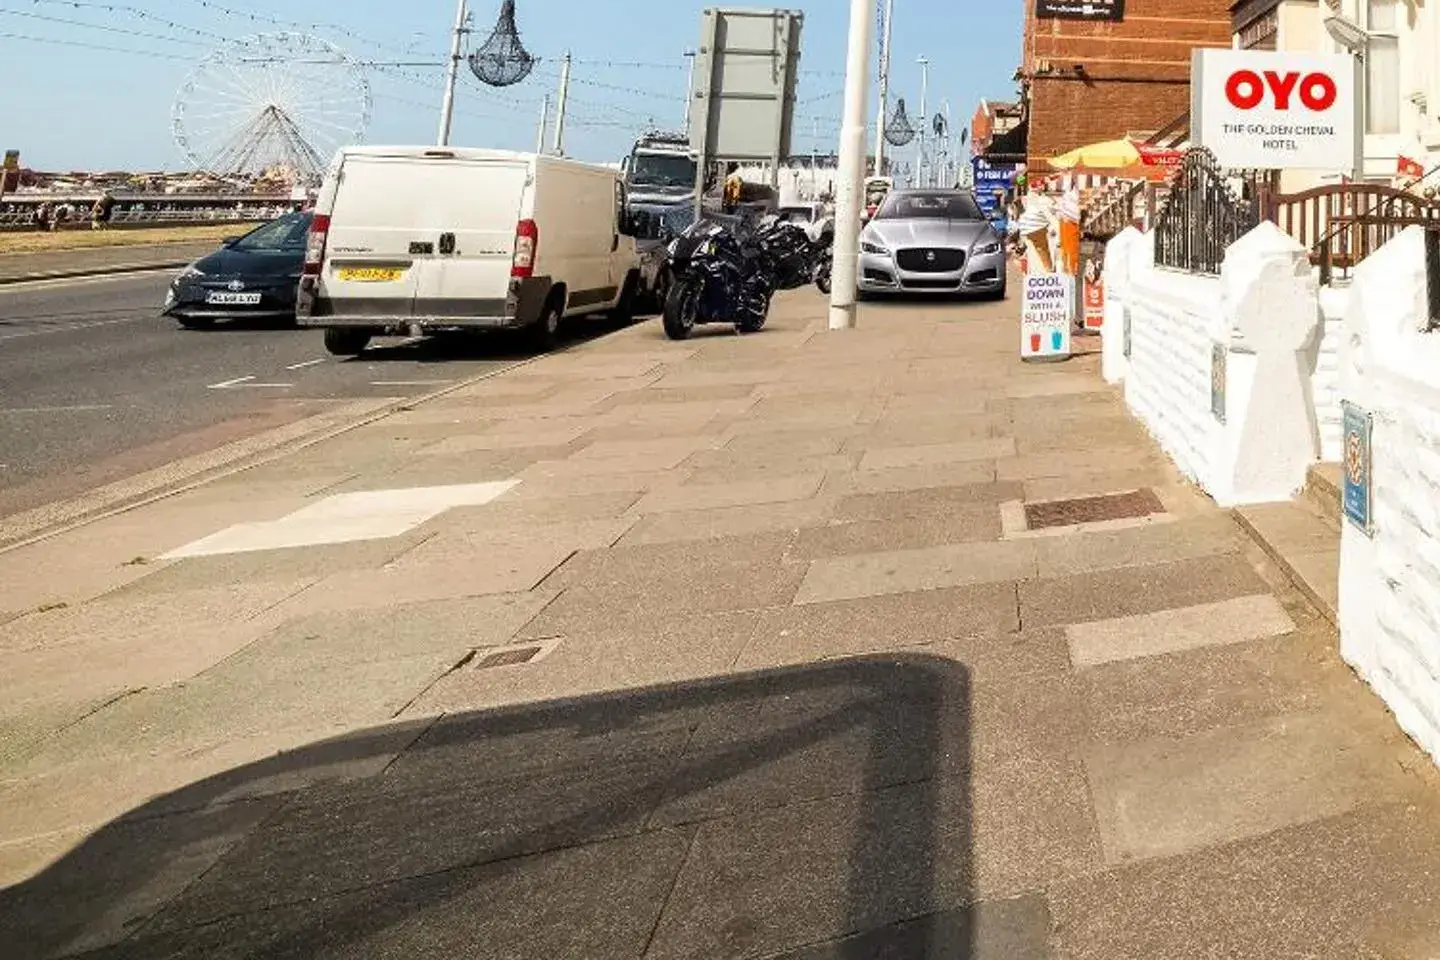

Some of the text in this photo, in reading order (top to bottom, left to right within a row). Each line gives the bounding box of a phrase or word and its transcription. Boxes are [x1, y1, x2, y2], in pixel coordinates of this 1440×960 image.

[1225, 69, 1337, 112] OYO
[1223, 124, 1335, 136] THE GOLDEN CHEVAL
[1263, 139, 1298, 150] HOTEL
[1028, 276, 1061, 287] COOL
[1027, 288, 1065, 300] DOWN
[1024, 311, 1067, 324] SLUSH
